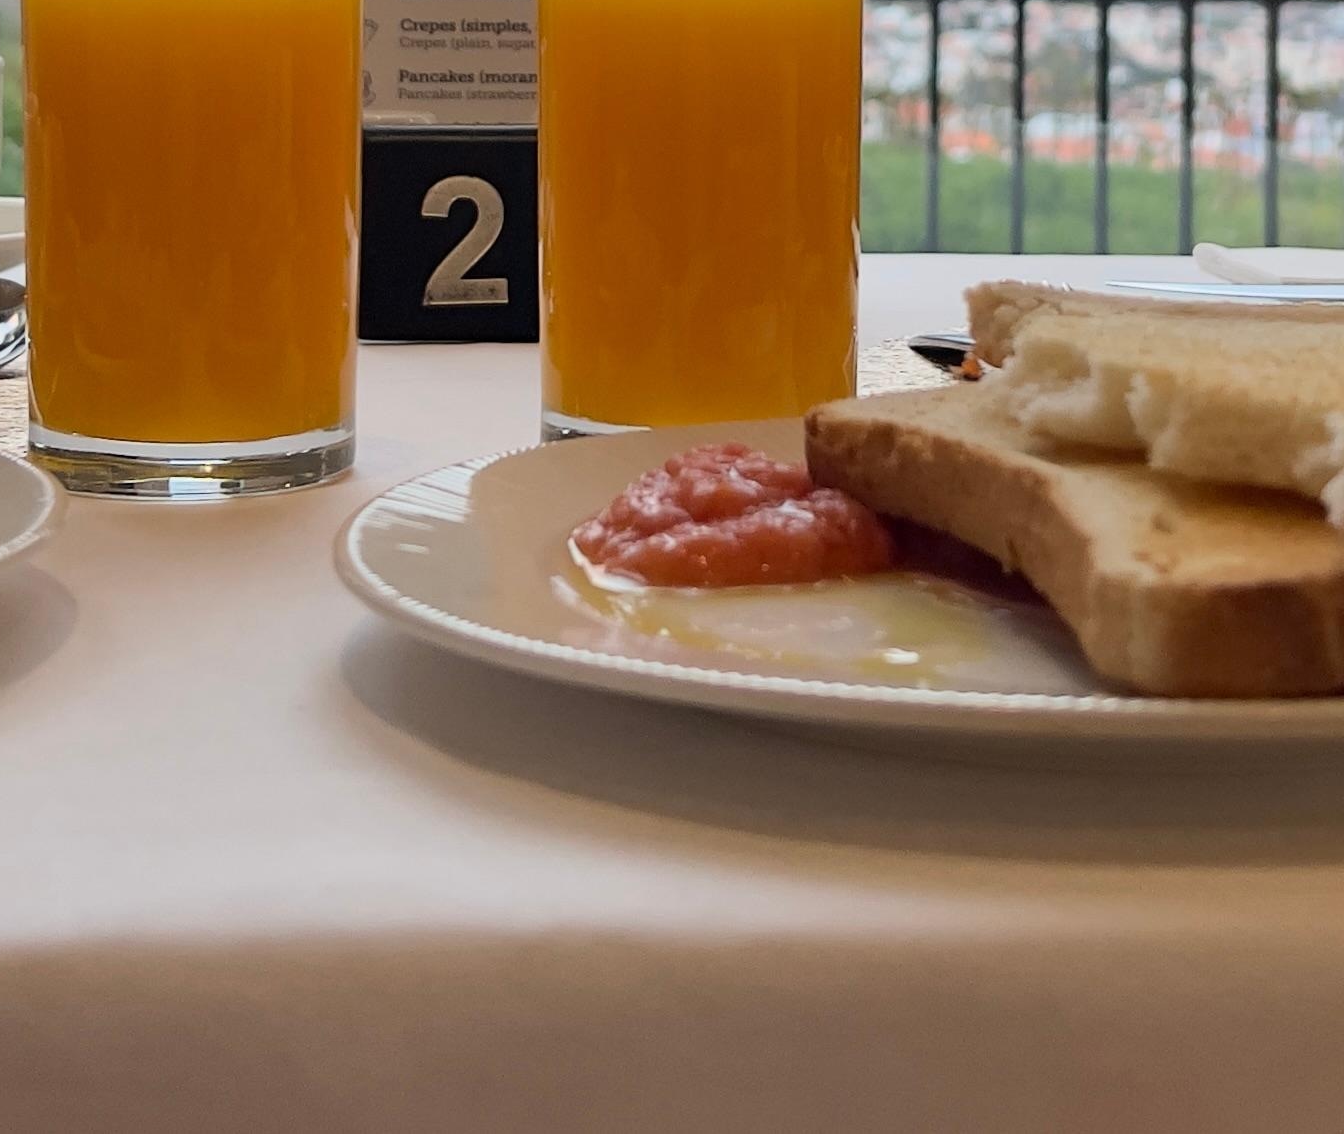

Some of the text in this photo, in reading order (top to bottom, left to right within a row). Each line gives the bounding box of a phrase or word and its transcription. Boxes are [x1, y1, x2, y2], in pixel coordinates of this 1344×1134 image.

[400, 18, 533, 36] Crepes (simples,
[398, 69, 475, 84] Pancakes
[421, 175, 509, 306] 2
